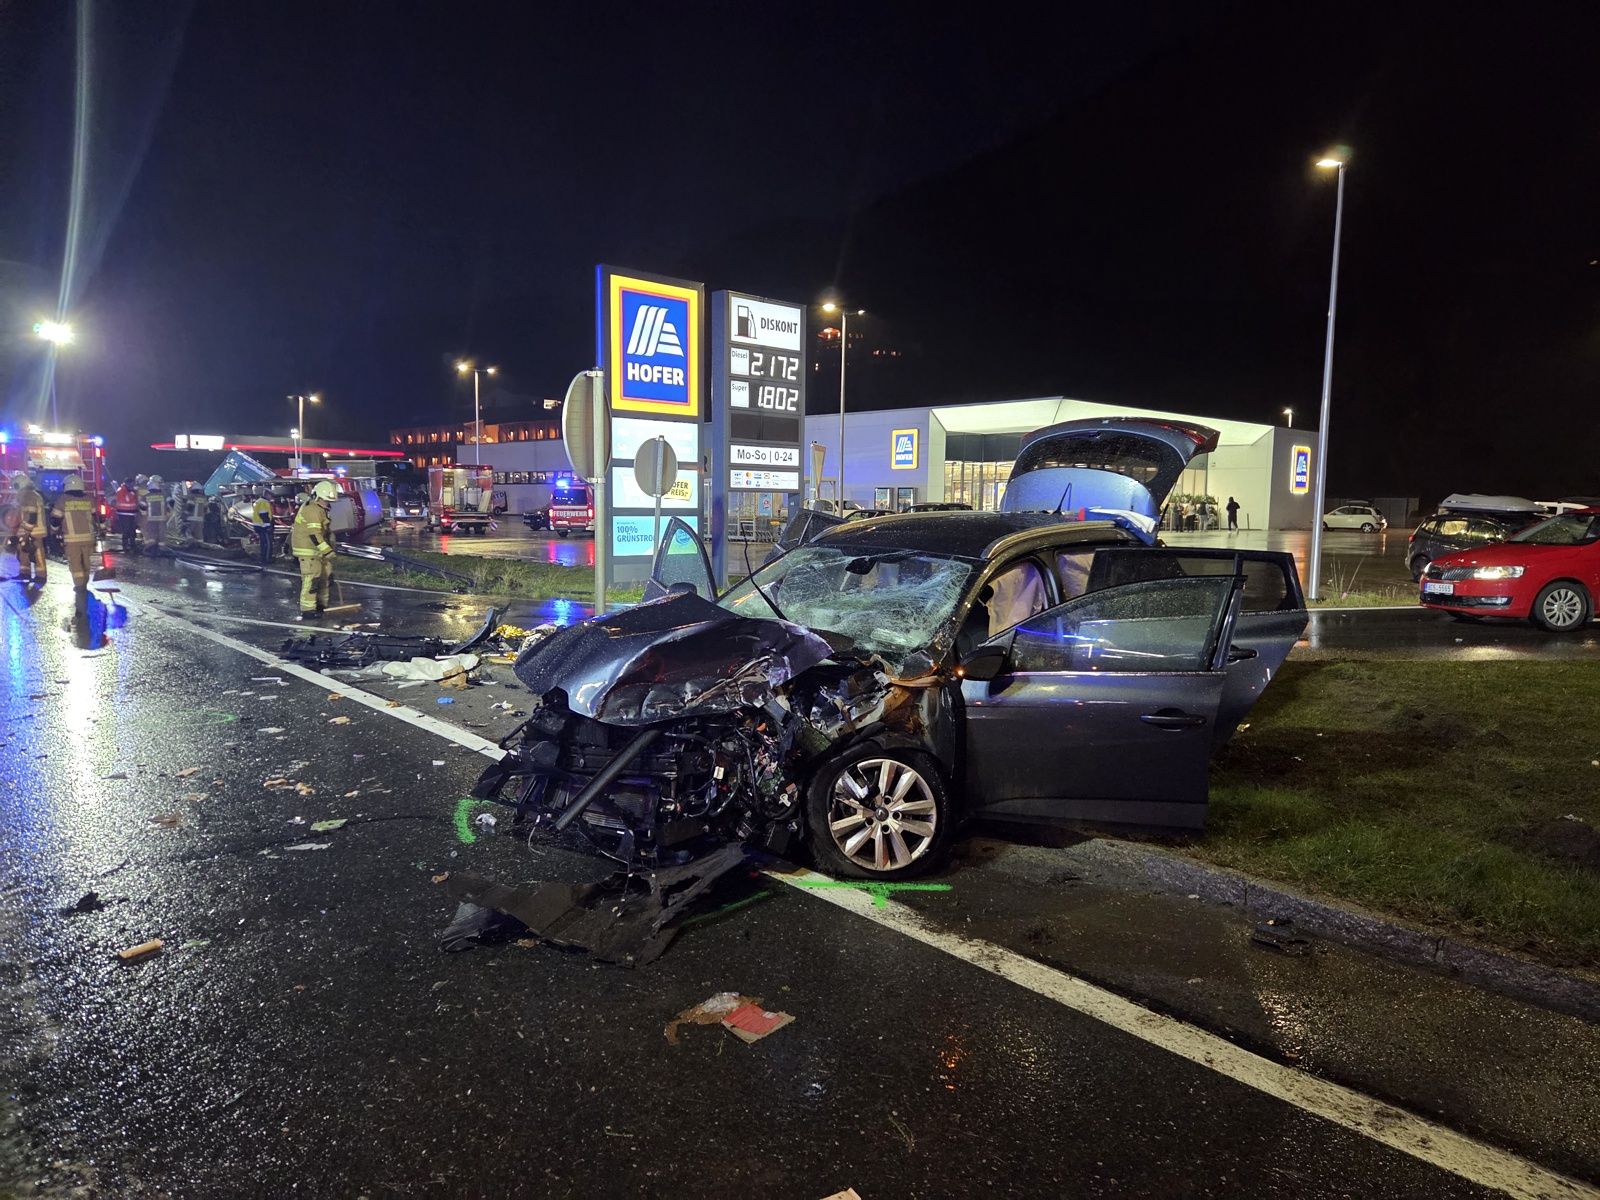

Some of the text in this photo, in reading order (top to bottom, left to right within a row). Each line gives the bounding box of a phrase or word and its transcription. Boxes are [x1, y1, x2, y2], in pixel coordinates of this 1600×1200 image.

[760, 317, 798, 334] DISKONT
[731, 350, 799, 380] Diesel 2.172
[627, 362, 685, 386] HOFER
[731, 384, 799, 411] Super 1.802
[737, 449, 793, 461] Mo-So 0-24
[616, 525, 639, 534] 100%
[616, 532, 653, 543] GRÜNSTRO
